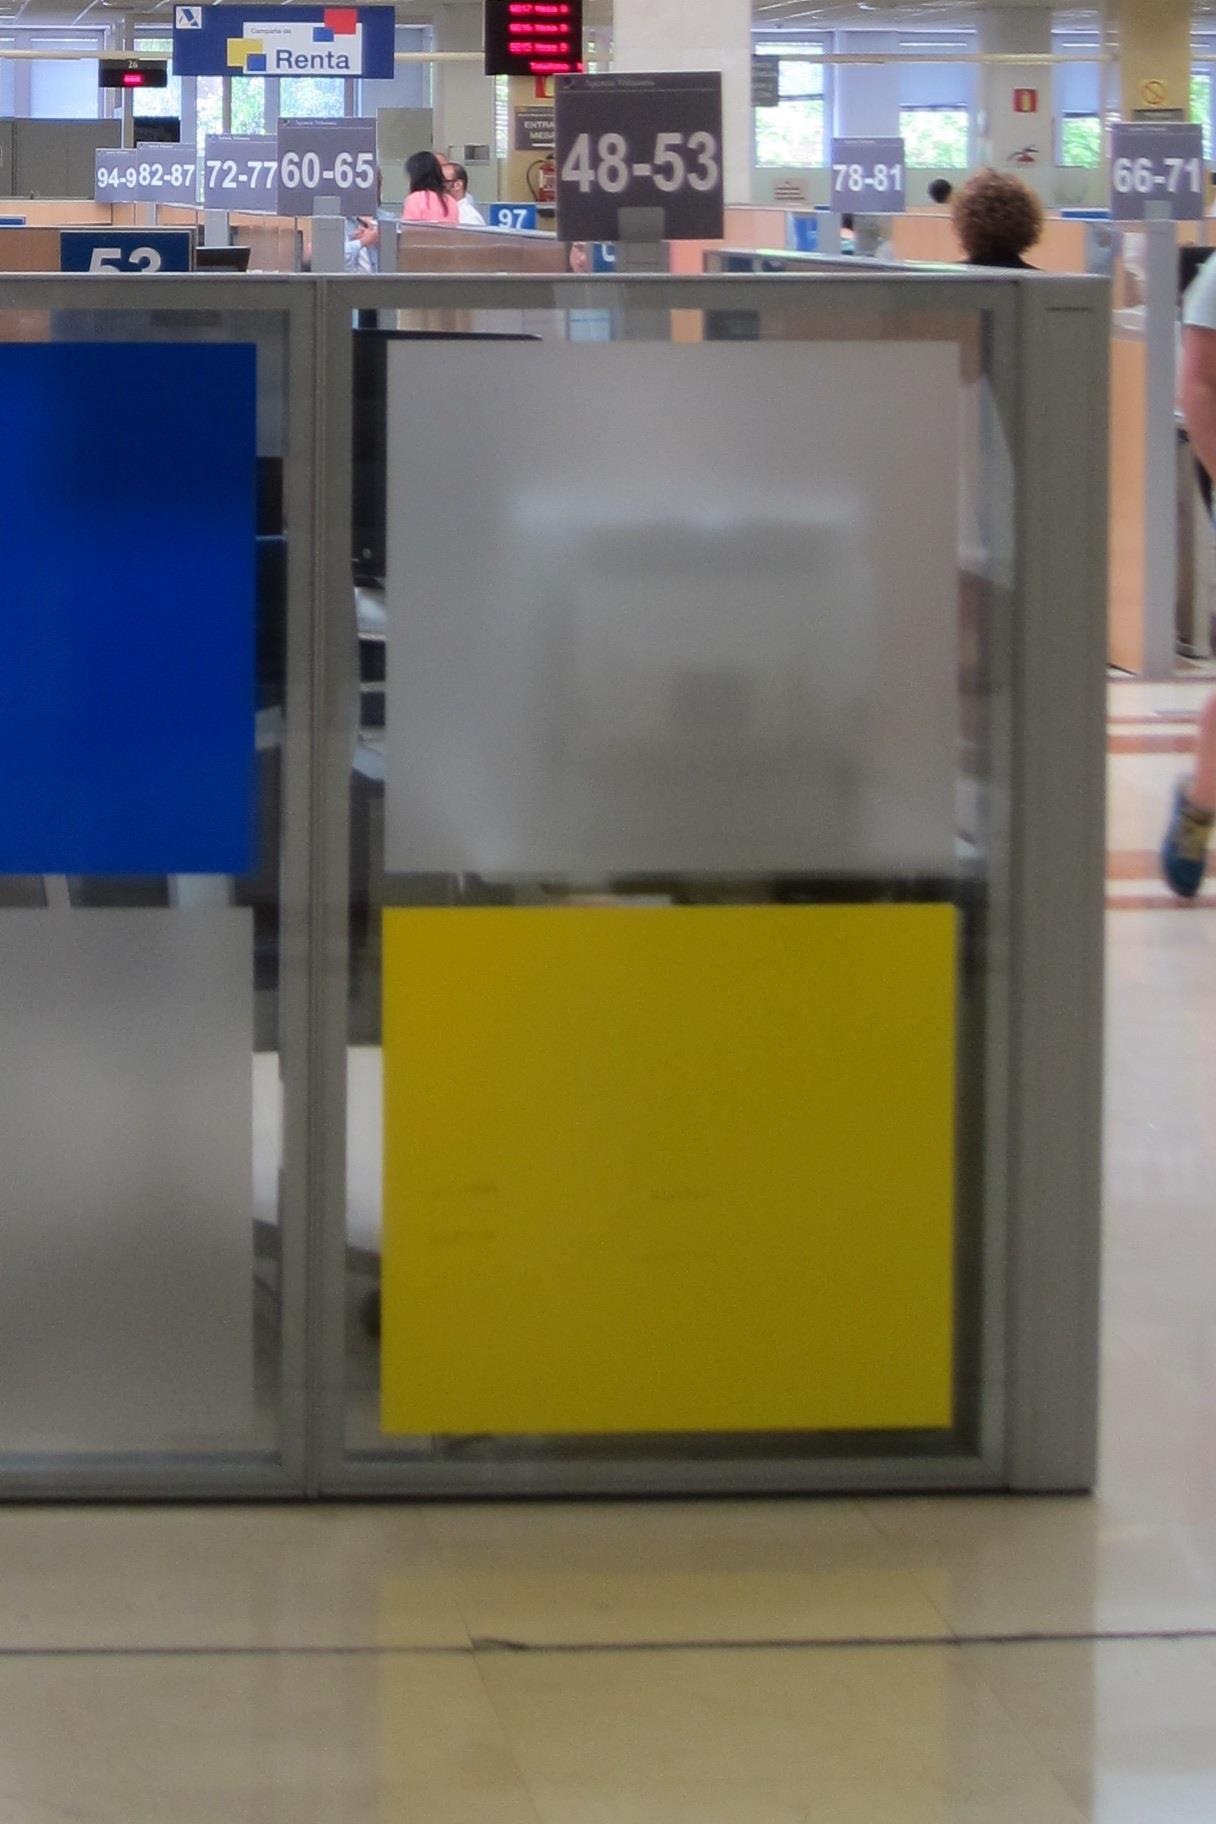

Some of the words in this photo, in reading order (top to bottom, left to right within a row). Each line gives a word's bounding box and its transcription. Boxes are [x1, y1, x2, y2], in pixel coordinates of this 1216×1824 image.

[275, 49, 350, 70] Renta
[138, 163, 195, 186] 82-87
[207, 160, 277, 188] 72-77
[281, 151, 375, 189] 60-65
[561, 131, 718, 193] 48-53
[1113, 157, 1200, 193] 66-71
[97, 167, 136, 188] 94-9
[833, 164, 902, 191] 78-81
[498, 209, 527, 229] 97
